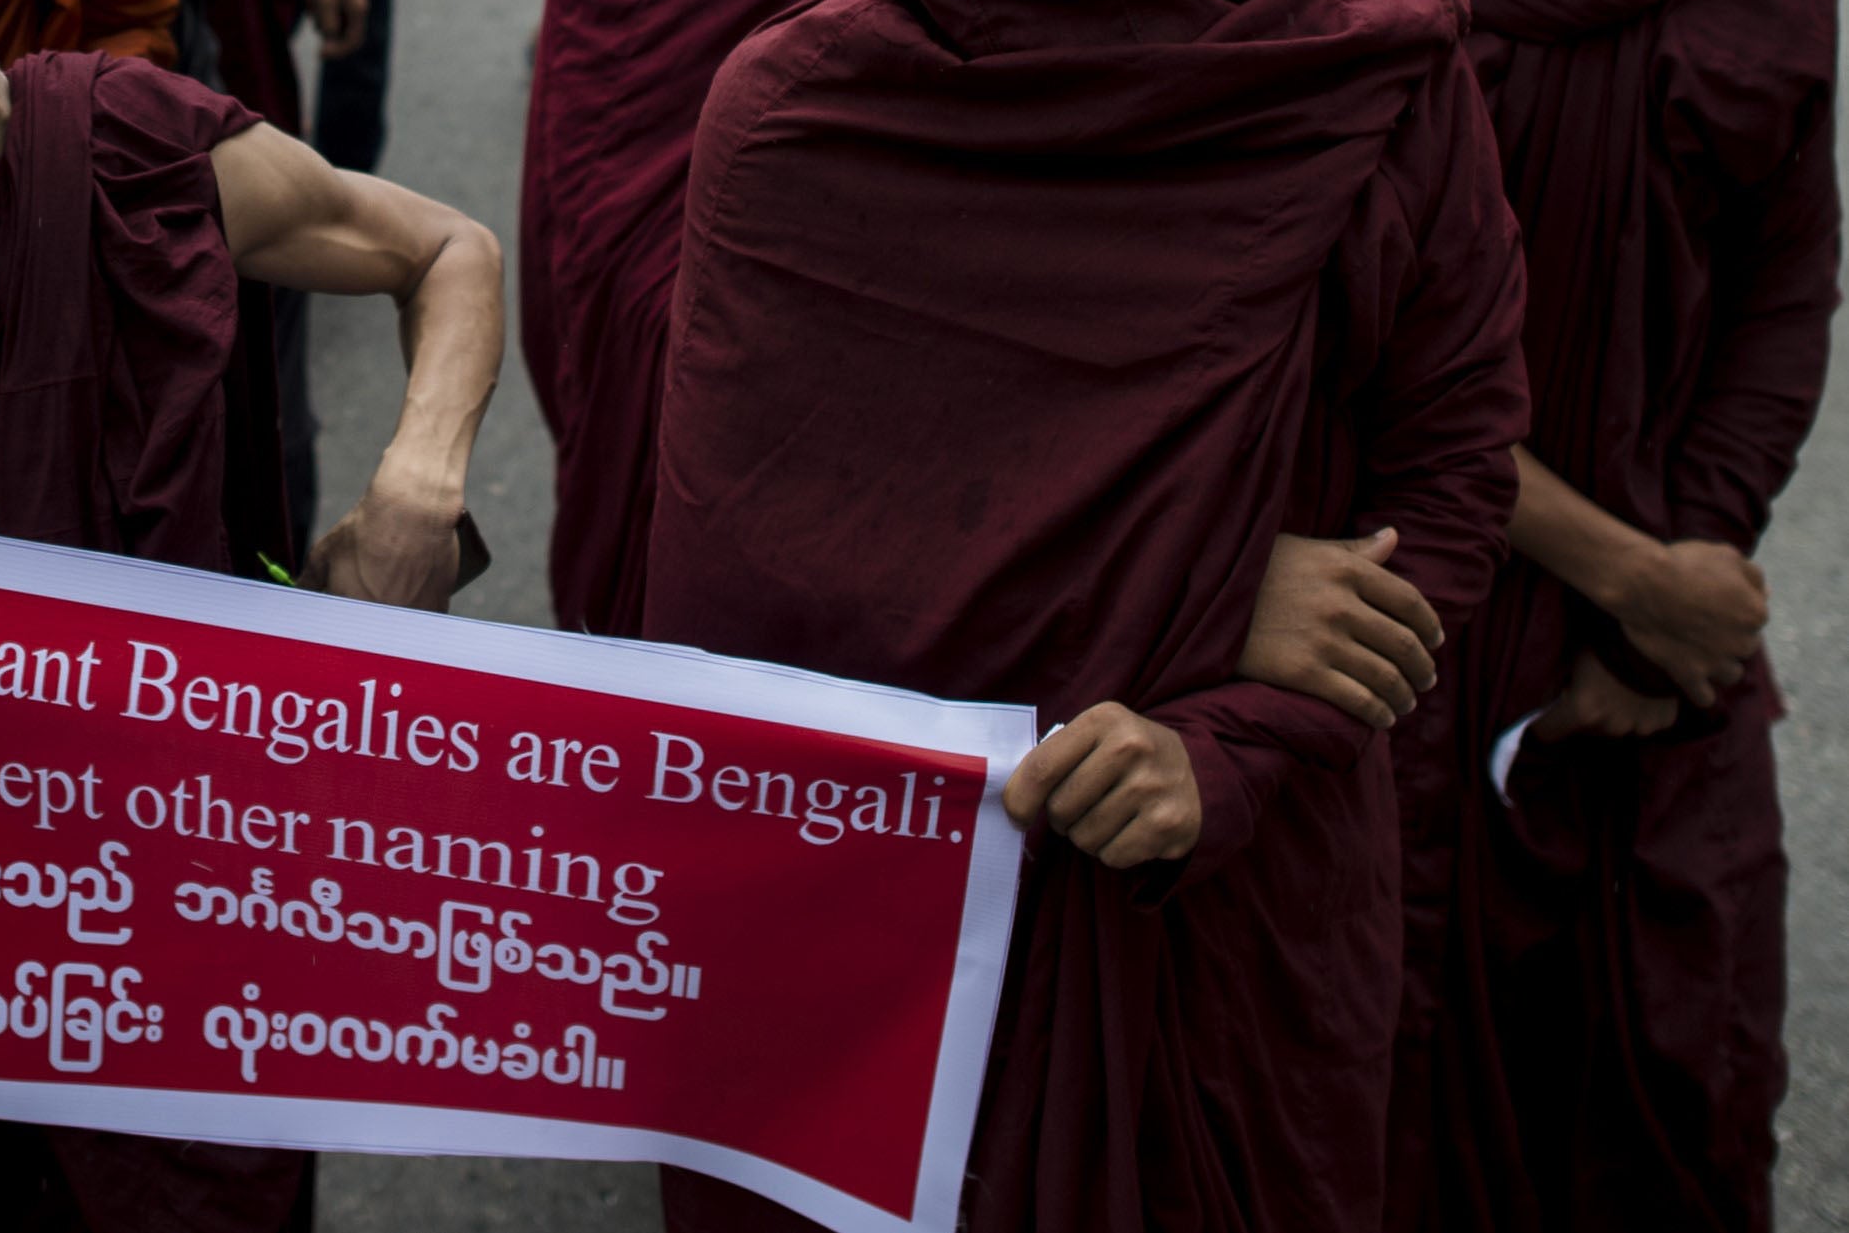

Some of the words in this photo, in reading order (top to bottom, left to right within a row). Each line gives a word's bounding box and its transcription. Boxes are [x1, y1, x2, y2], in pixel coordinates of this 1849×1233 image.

[119, 640, 480, 773] Bengalies
[506, 731, 620, 793] are
[644, 731, 963, 845] Bengali.
[125, 774, 311, 856] other
[325, 817, 665, 926] naming
[203, 983, 626, 1091] လုံးဝလက်မခံပါ။
